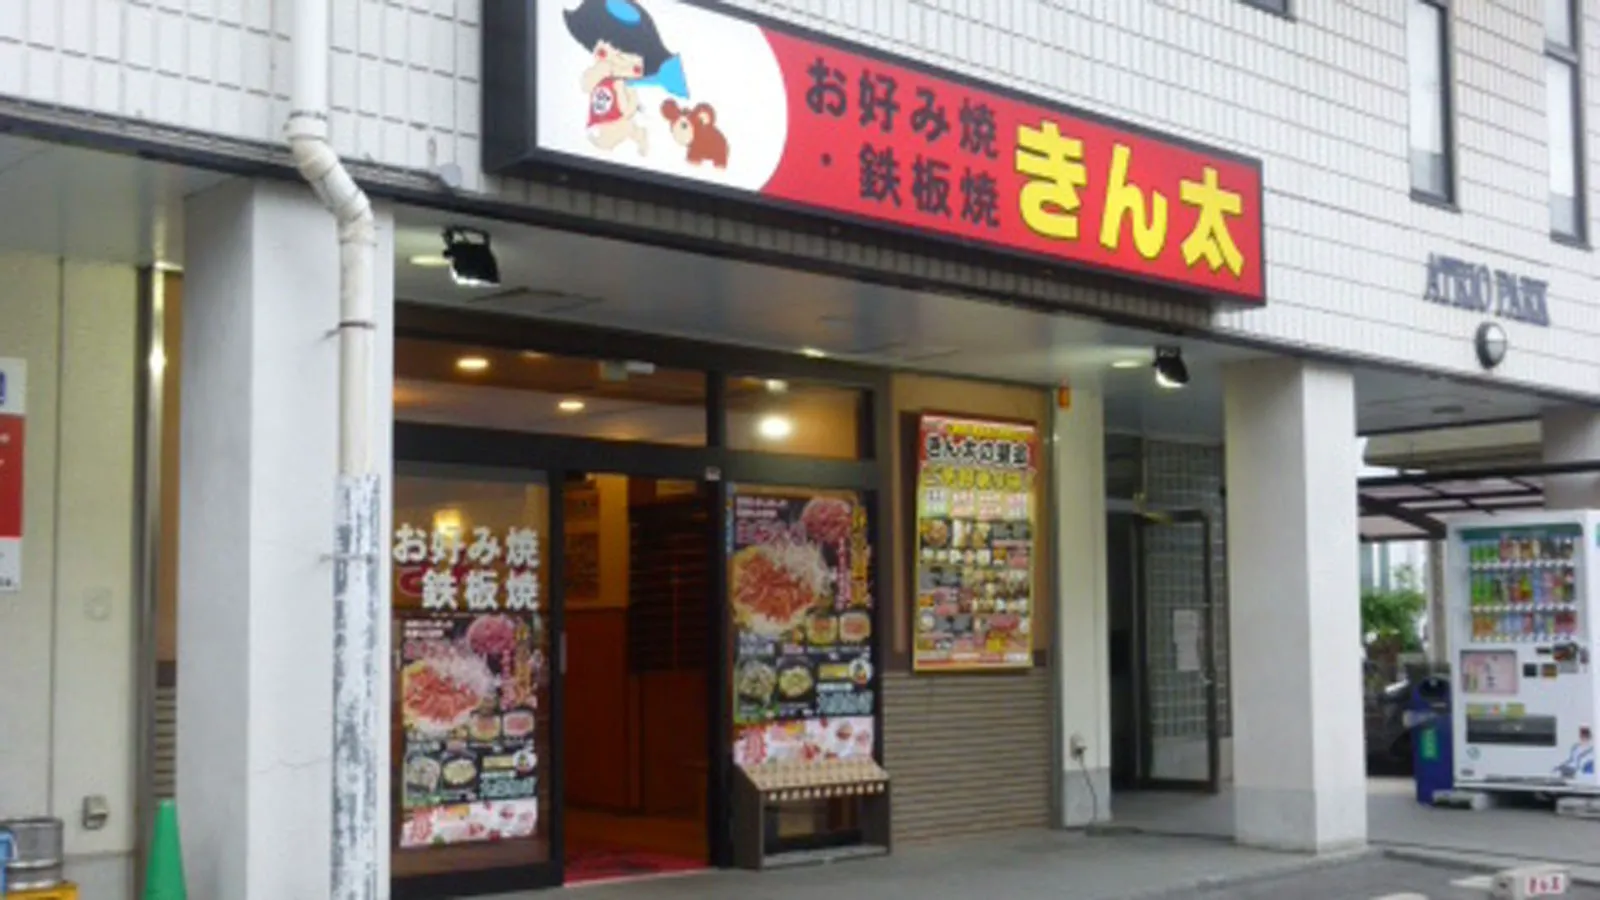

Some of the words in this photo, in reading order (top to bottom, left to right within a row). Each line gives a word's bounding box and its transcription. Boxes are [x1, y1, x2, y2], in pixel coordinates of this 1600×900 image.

[806, 57, 999, 160] お好み焼
[1014, 119, 1245, 278] きん太
[1494, 269, 1550, 327] PARK
[392, 523, 540, 567] お好み焼
[421, 568, 541, 611] 鉄板焼
